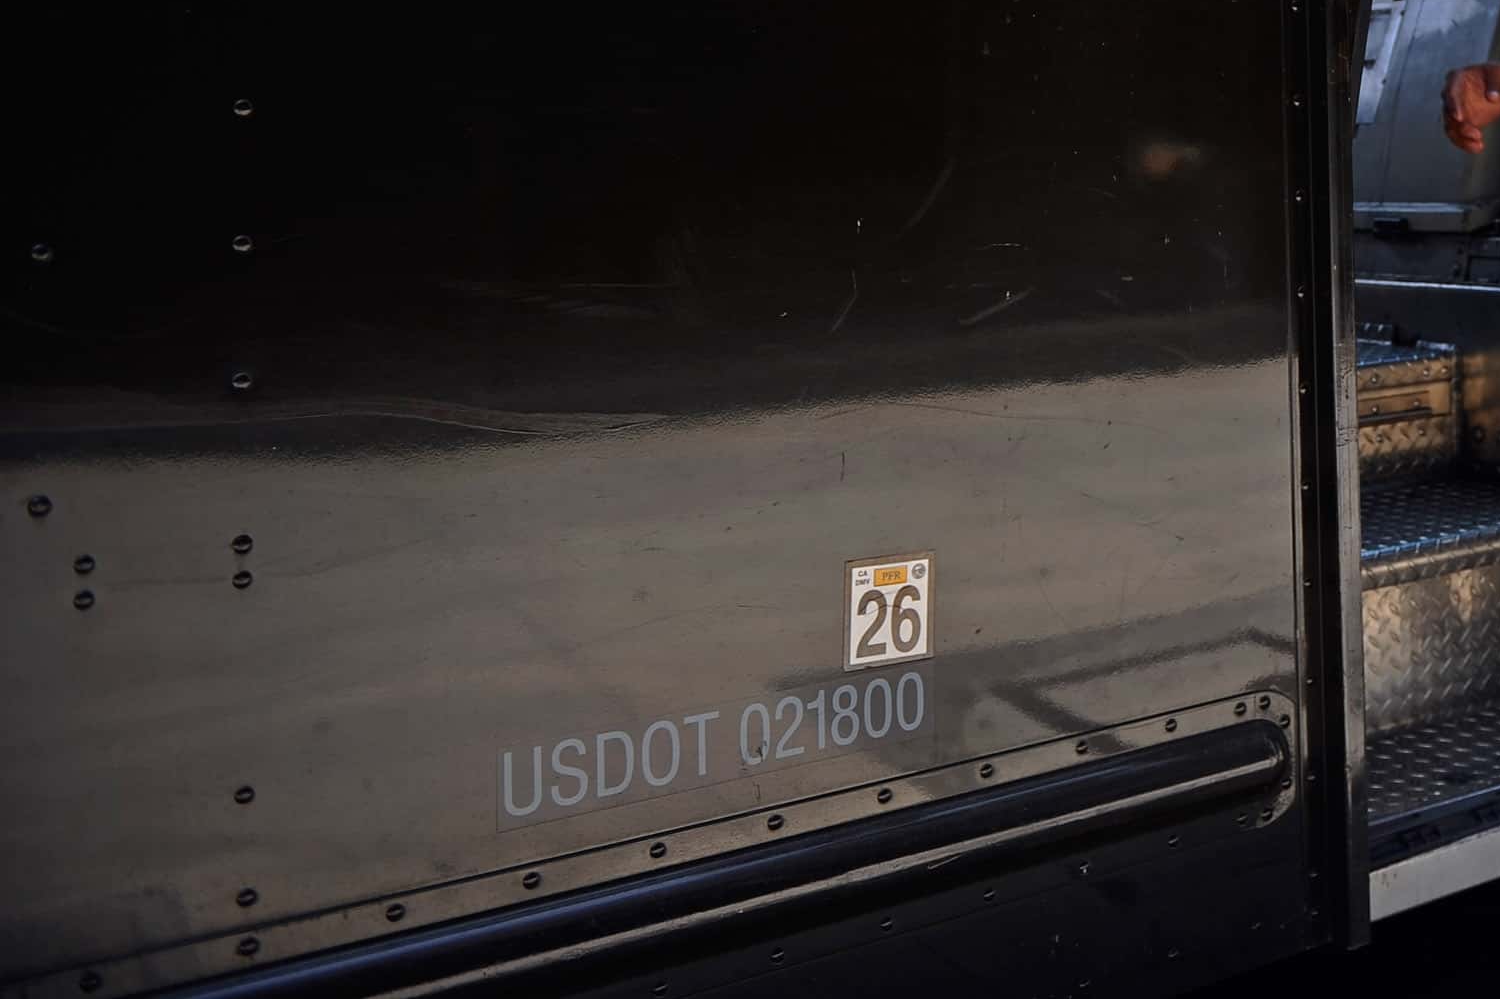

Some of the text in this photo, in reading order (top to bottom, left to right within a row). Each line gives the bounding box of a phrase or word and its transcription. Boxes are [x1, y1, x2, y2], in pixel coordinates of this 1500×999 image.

[858, 569, 868, 577] CA
[856, 585, 921, 658] 26
[502, 671, 925, 817] USDOT 021800
